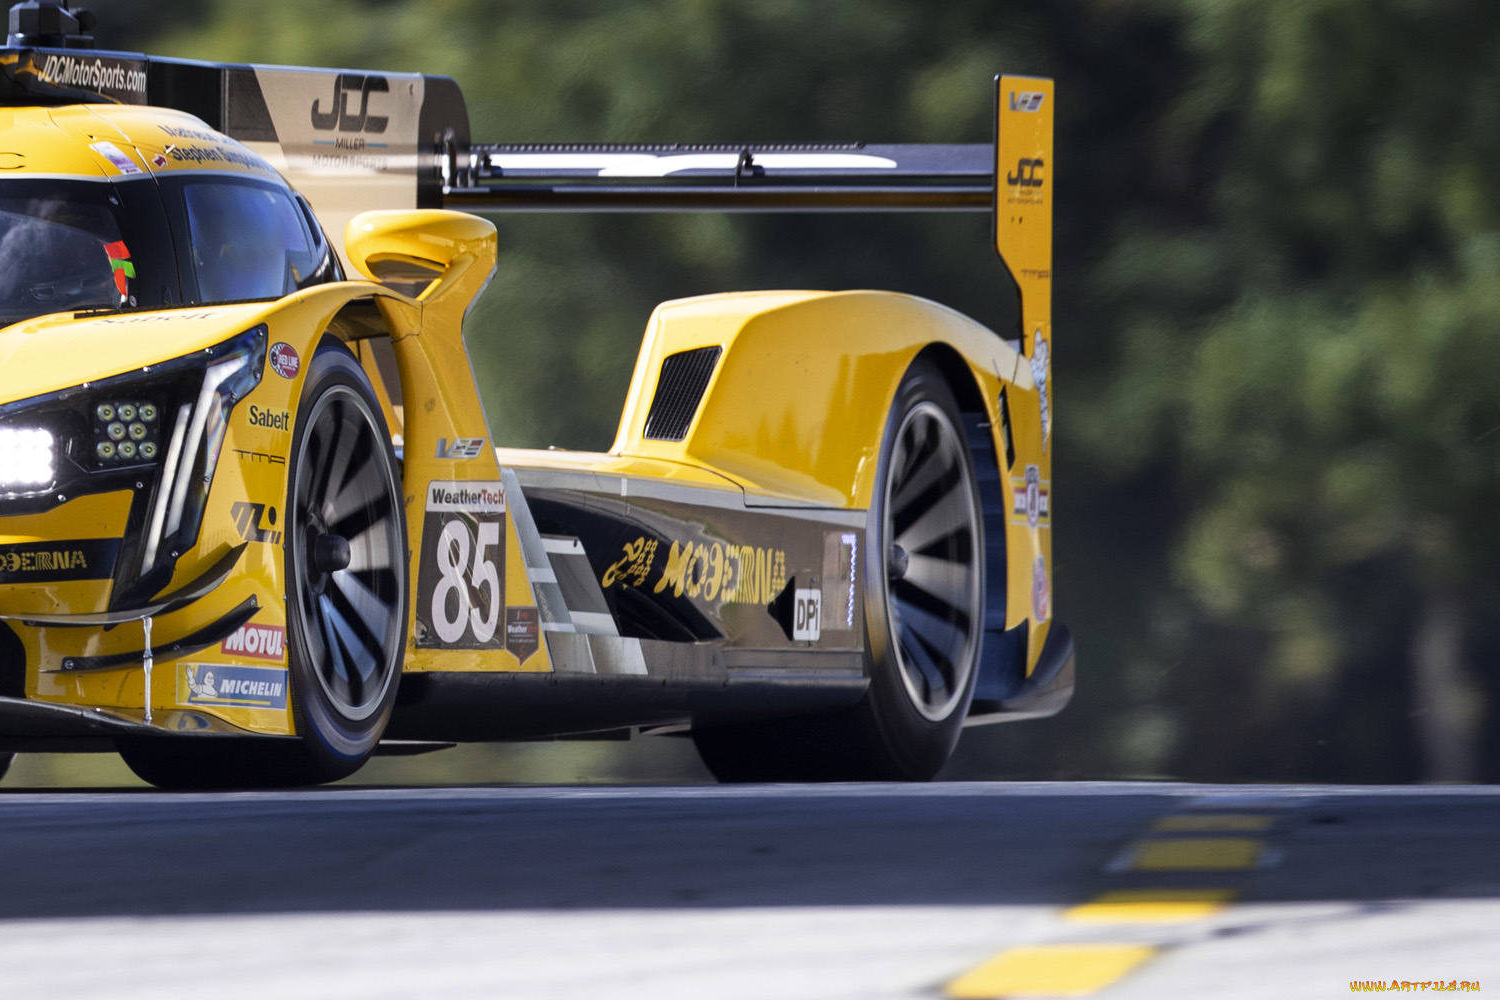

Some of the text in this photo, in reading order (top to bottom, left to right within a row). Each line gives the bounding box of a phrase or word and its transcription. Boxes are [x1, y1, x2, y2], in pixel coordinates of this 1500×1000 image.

[38, 55, 146, 94] JDCMotorSports.com
[311, 73, 389, 134] JDC
[335, 137, 365, 150] MILLER
[312, 154, 388, 171] MOTORSPORTS
[1007, 158, 1044, 187] JDC
[249, 405, 290, 431] Sabelt
[432, 488, 504, 505] WeatherTech
[431, 519, 500, 643] 85
[796, 598, 819, 632] DPi
[225, 626, 283, 655] MOTUL
[220, 679, 282, 697] MICHELIN
